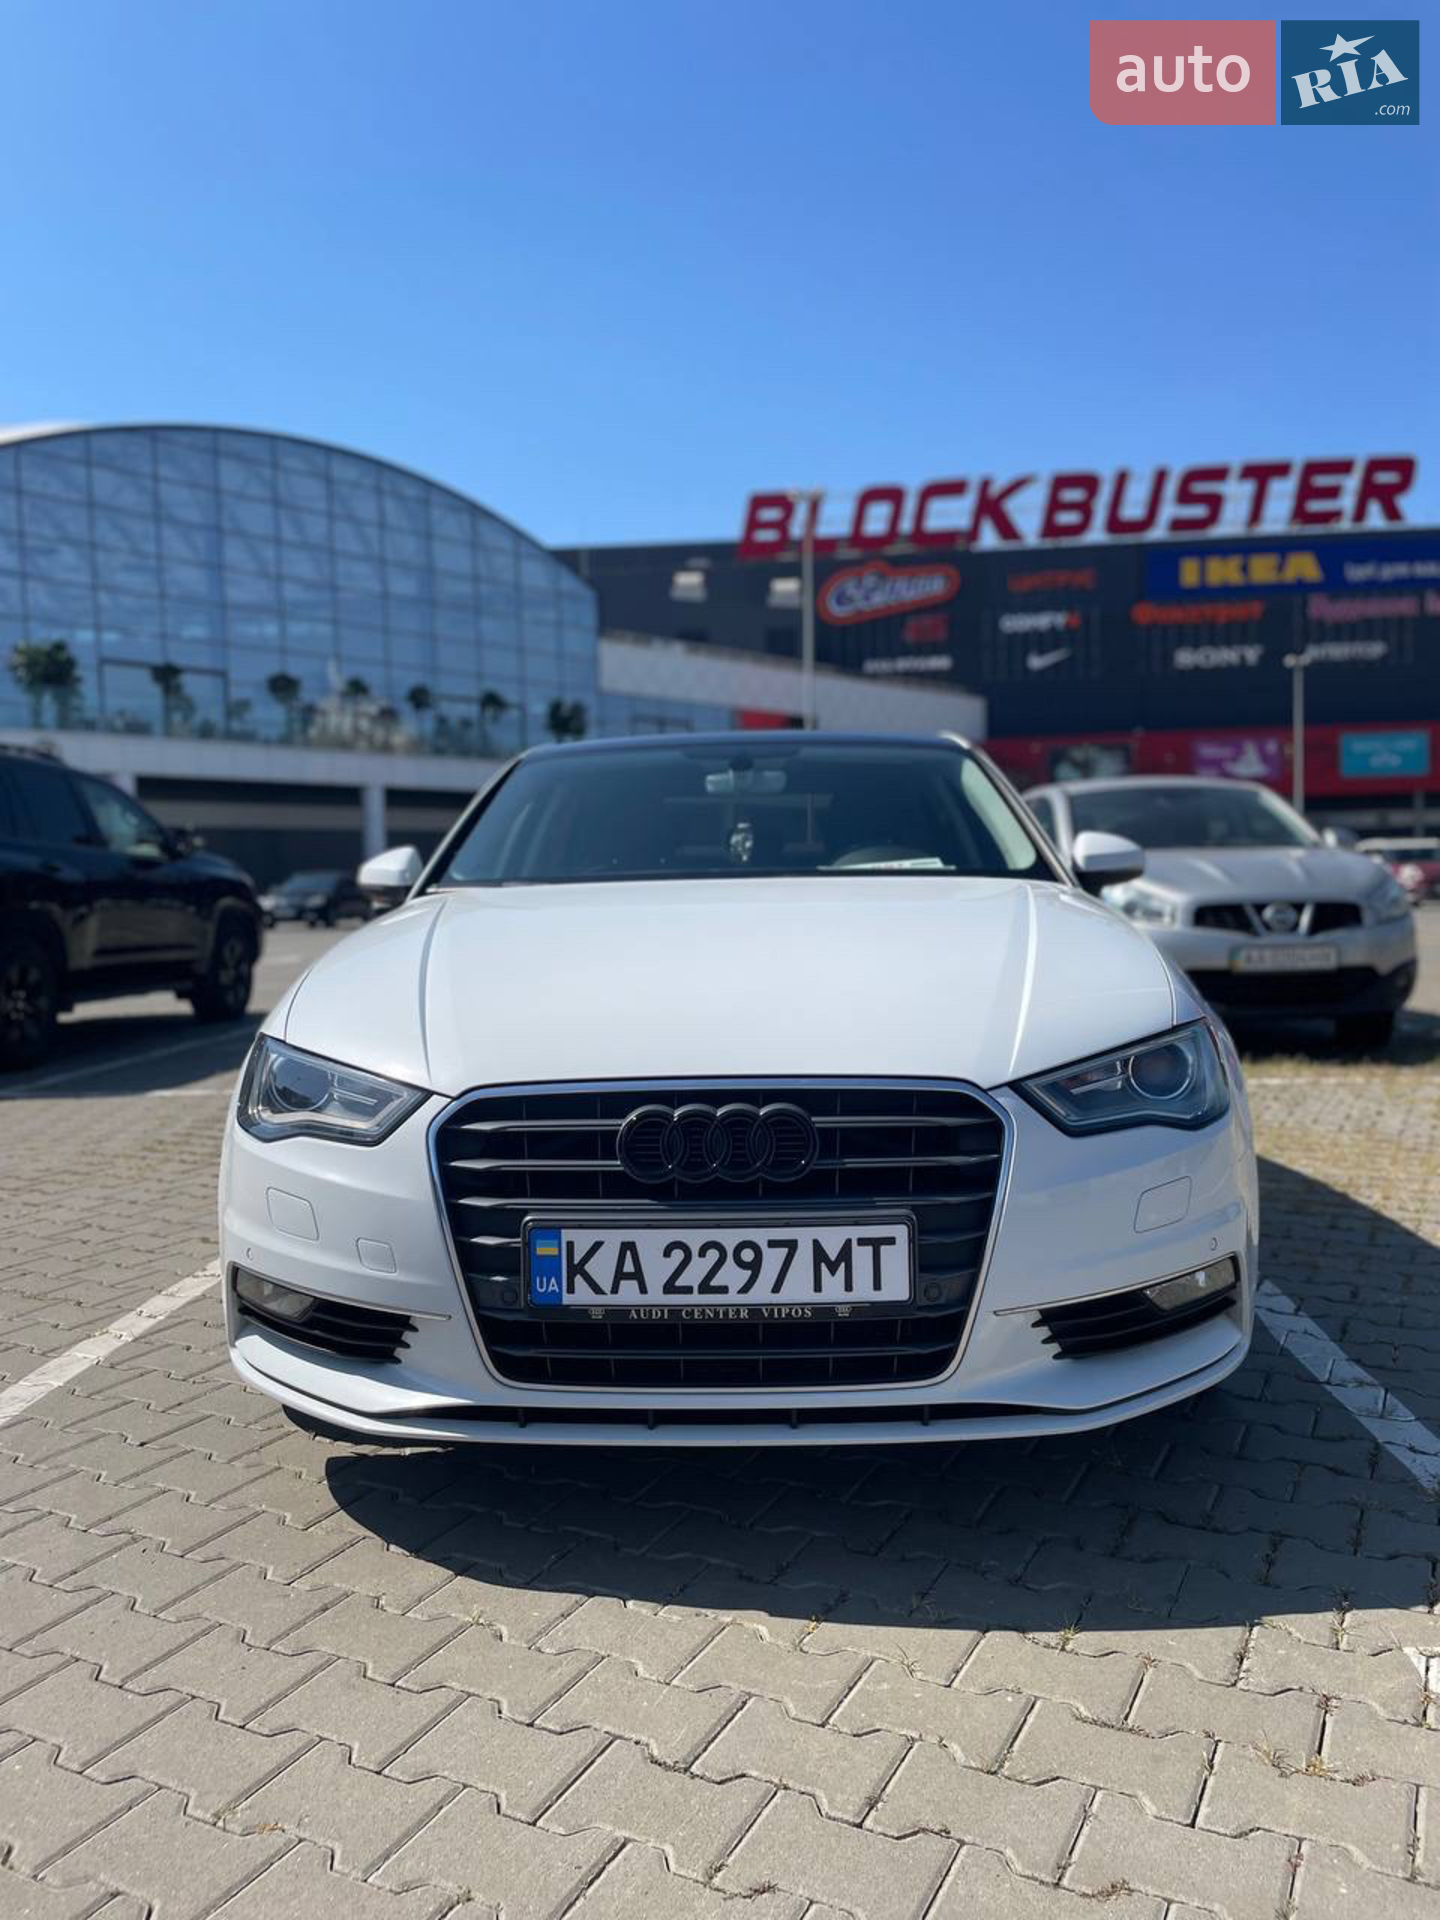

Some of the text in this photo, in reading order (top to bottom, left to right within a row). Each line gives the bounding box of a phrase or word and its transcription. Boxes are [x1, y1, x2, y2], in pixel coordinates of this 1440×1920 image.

[738, 457, 1416, 560] BLOCKBUSTER
[1179, 552, 1324, 589] IKEA
[1174, 645, 1263, 669] SONY
[565, 1236, 897, 1296] KA 2297 MT
[536, 1275, 559, 1294] UA
[629, 1306, 812, 1320] AUDI CENTER VIPOS
